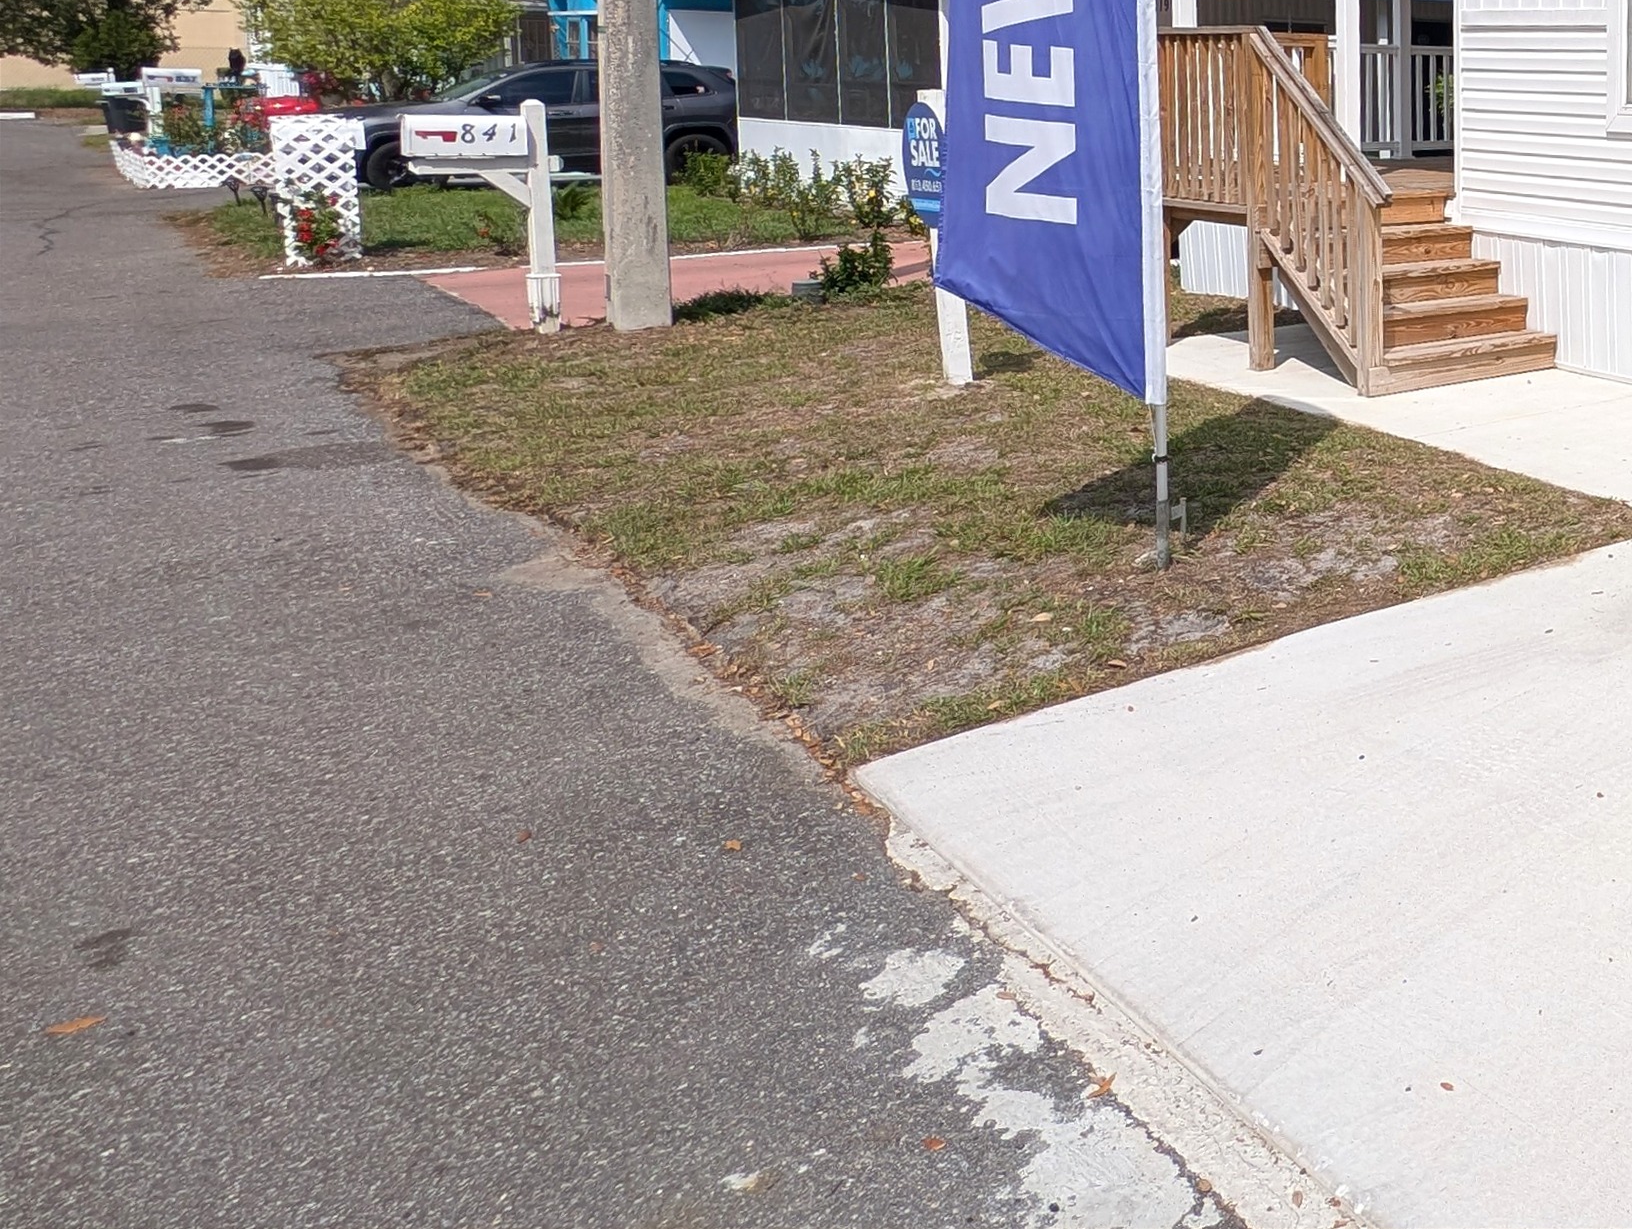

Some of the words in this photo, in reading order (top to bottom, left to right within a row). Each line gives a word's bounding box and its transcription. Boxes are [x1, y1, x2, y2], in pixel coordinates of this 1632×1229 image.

[460, 123, 517, 143] 841
[915, 117, 937, 139] FOR
[910, 140, 940, 167] SALE
